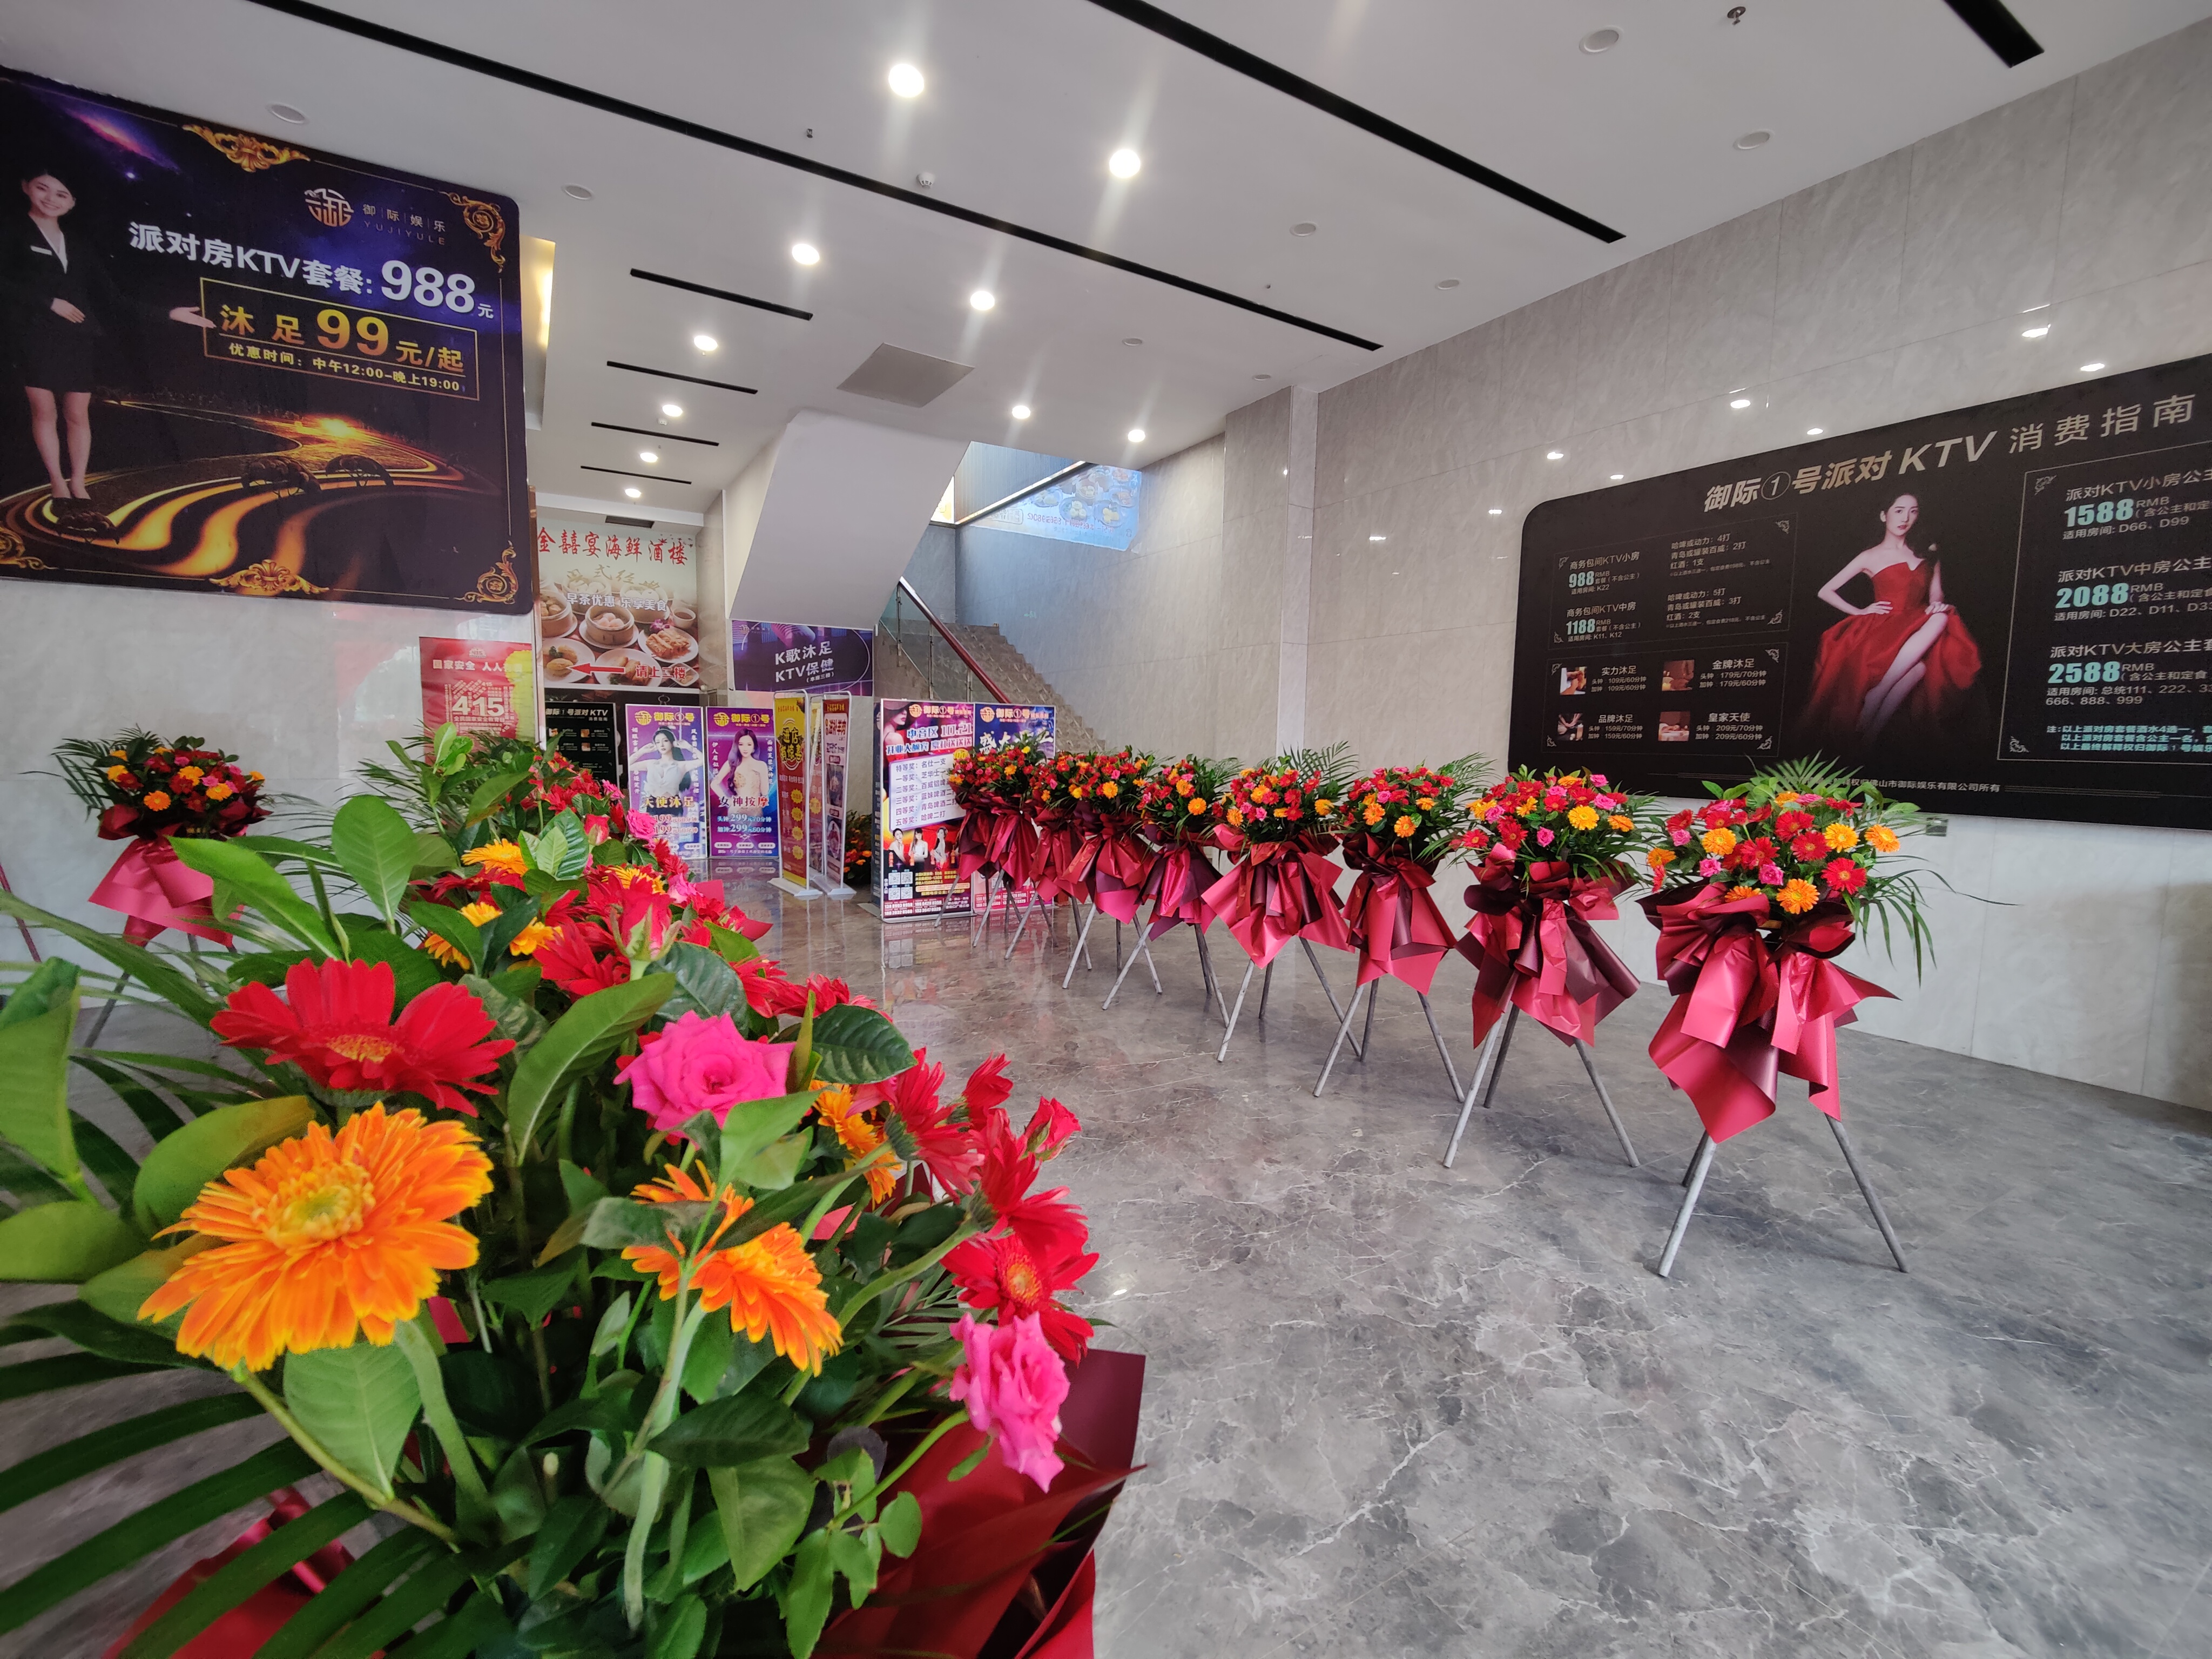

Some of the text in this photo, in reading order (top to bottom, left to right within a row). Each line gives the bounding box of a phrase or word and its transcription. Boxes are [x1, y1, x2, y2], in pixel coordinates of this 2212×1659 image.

[2009, 394, 2196, 454] 消费指南
[2064, 496, 2170, 528] 1588 RMB
[1570, 551, 1640, 570] 商务包间KTV小房
[1569, 571, 1594, 588] 988
[2055, 583, 2164, 609] 2088 RMB
[1567, 601, 1636, 617] 商务包间KTV中房
[1566, 618, 1595, 635] 1188
[636, 665, 686, 679] 请上二楼
[1602, 658, 1755, 676] 实力沐足 金牌沐足
[2047, 661, 2155, 684] 2588 RMB
[453, 696, 504, 716] 415
[1599, 712, 1751, 723] 品牌沐足 皇家天使
[718, 796, 769, 808] 女神按摩
